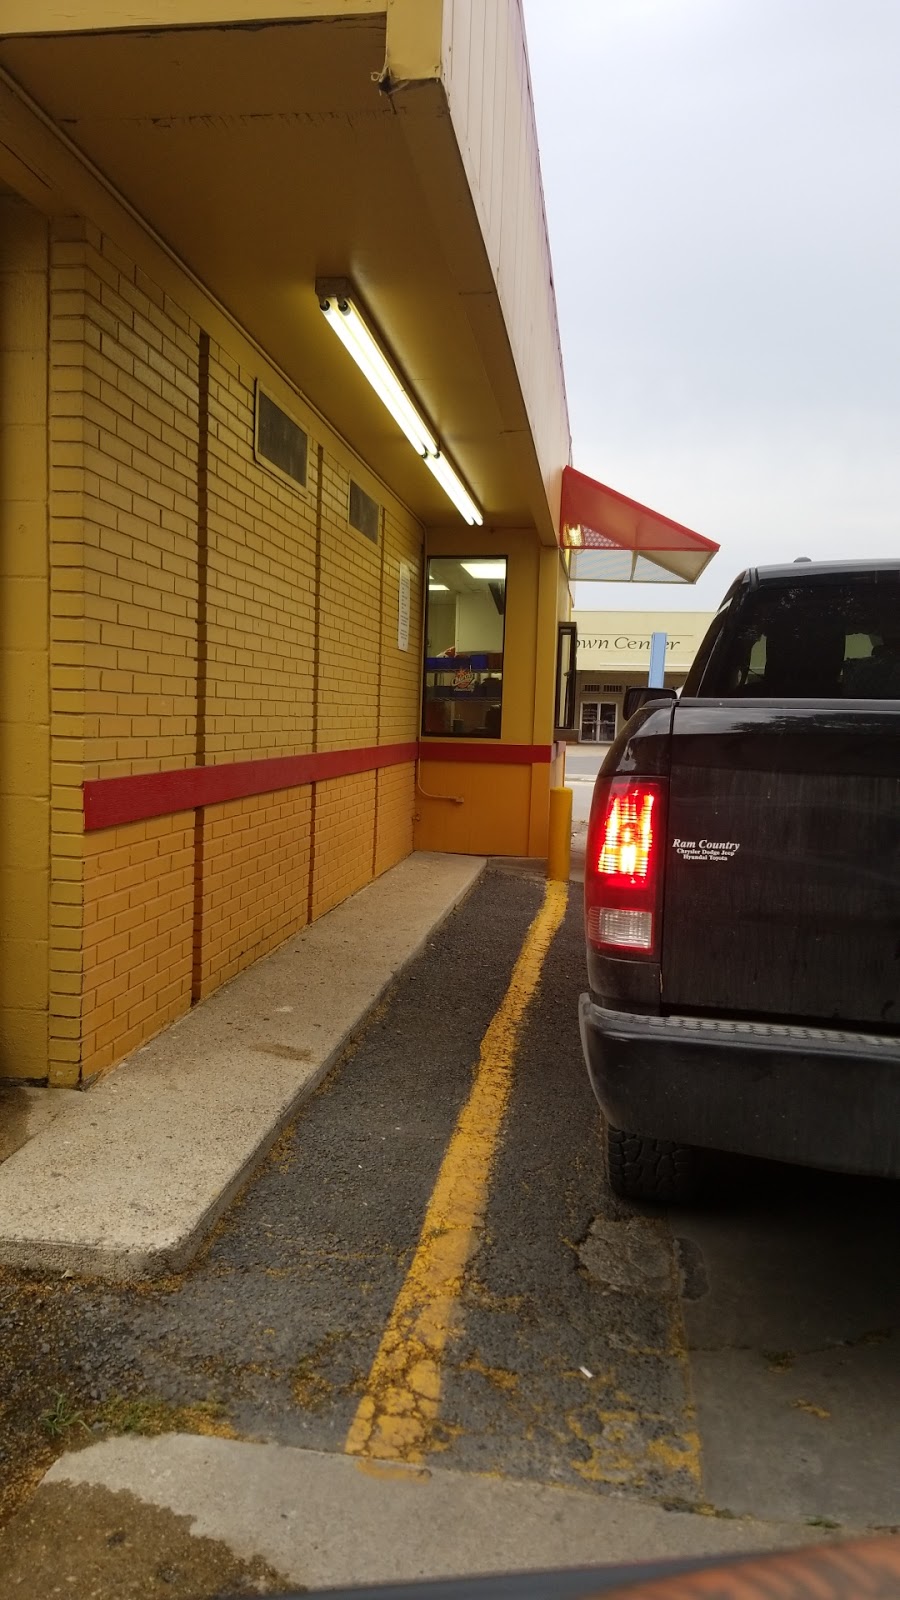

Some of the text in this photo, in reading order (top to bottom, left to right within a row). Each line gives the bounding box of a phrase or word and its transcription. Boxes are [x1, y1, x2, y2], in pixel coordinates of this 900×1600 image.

[614, 636, 681, 650] Cener
[672, 838, 740, 852] Ram Country
